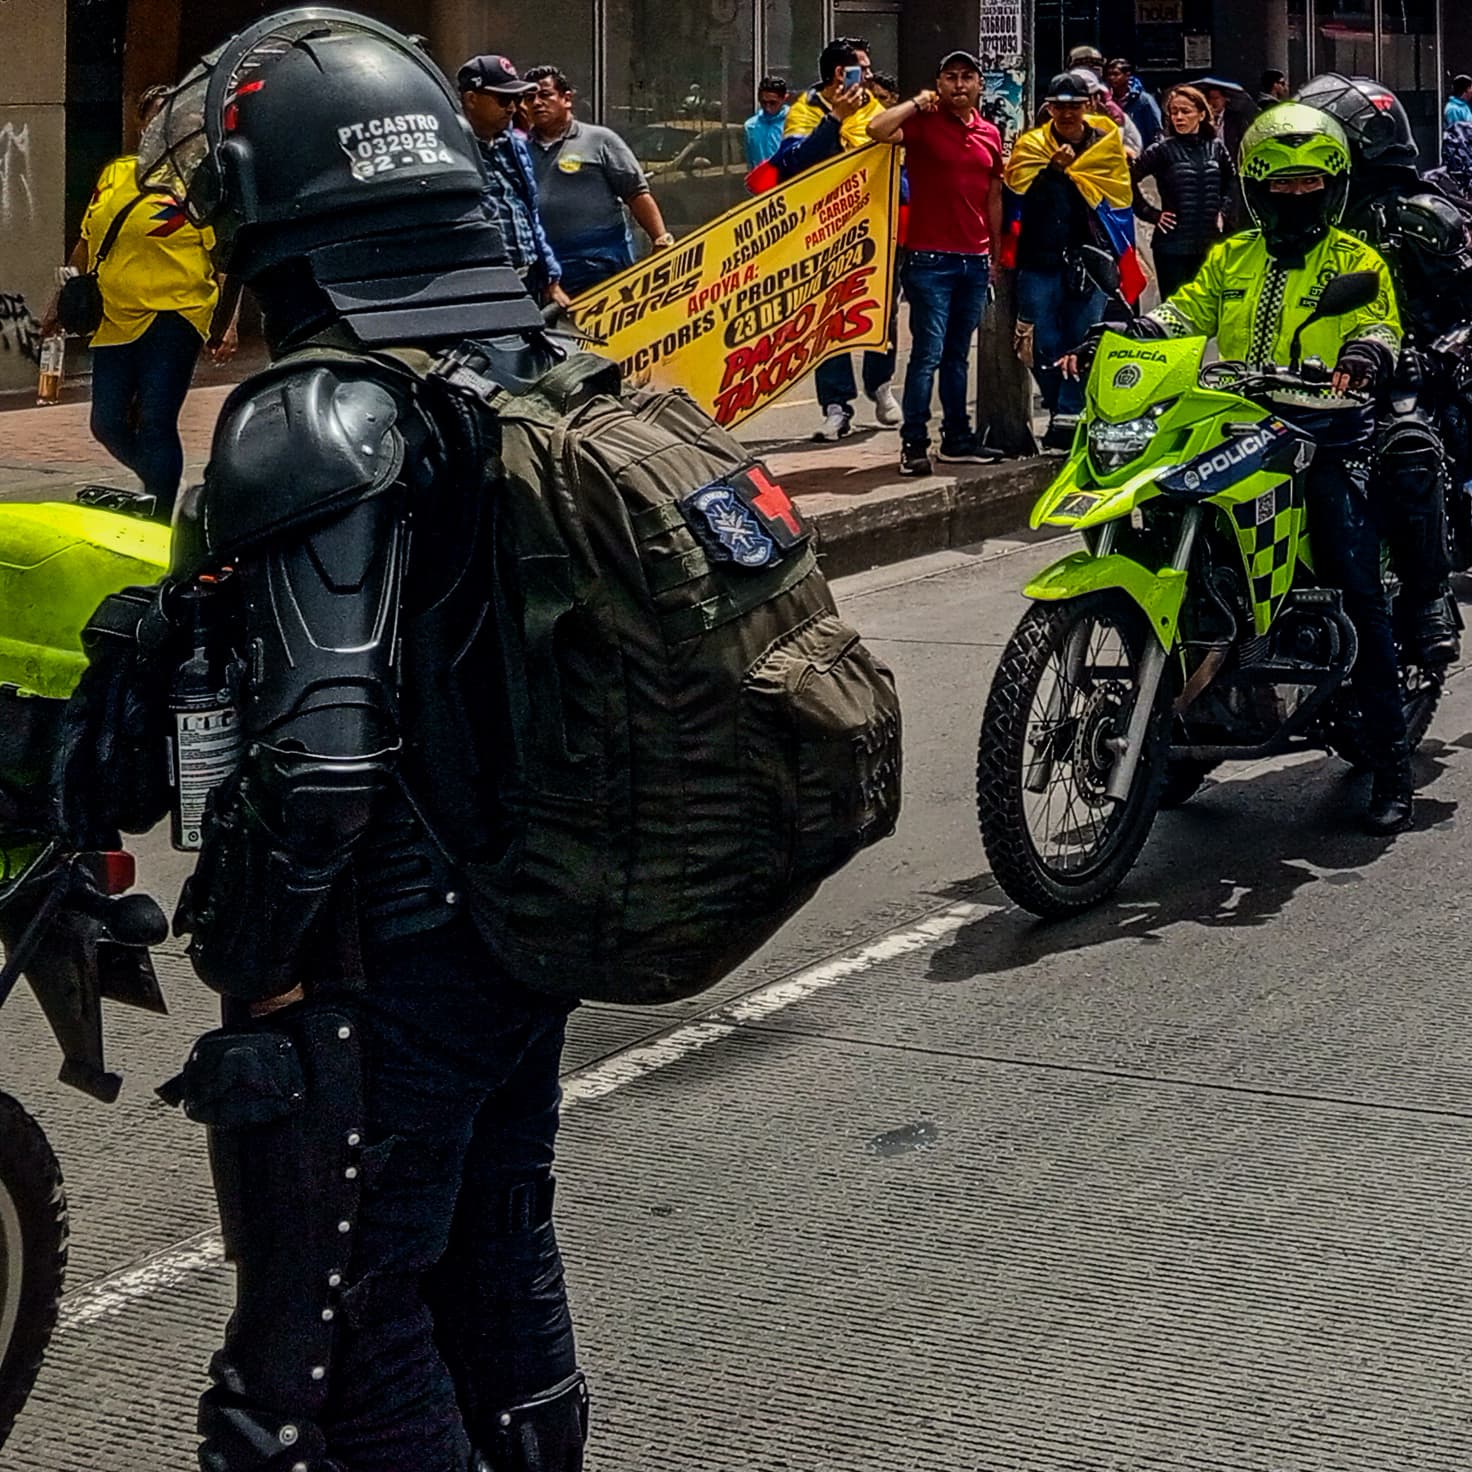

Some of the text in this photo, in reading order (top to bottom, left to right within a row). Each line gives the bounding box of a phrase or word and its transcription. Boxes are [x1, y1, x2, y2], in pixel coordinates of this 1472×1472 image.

[338, 114, 439, 144] PT.CASTRO
[358, 132, 437, 158] 032925
[819, 189, 861, 225] CARROS
[825, 173, 860, 207] MOTOS
[860, 168, 867, 184] Y
[733, 195, 787, 247] NO MÁS
[687, 264, 760, 318] APOYA A:
[720, 299, 732, 322] Y
[736, 218, 870, 313] PROPIETARIOS
[733, 243, 863, 345] 23 DE JULIO 2024
[592, 271, 703, 340] LIBRES
[718, 265, 879, 395] PARO DE
[712, 298, 881, 427] TAXISTAS
[1107, 350, 1168, 364] POLICÍA
